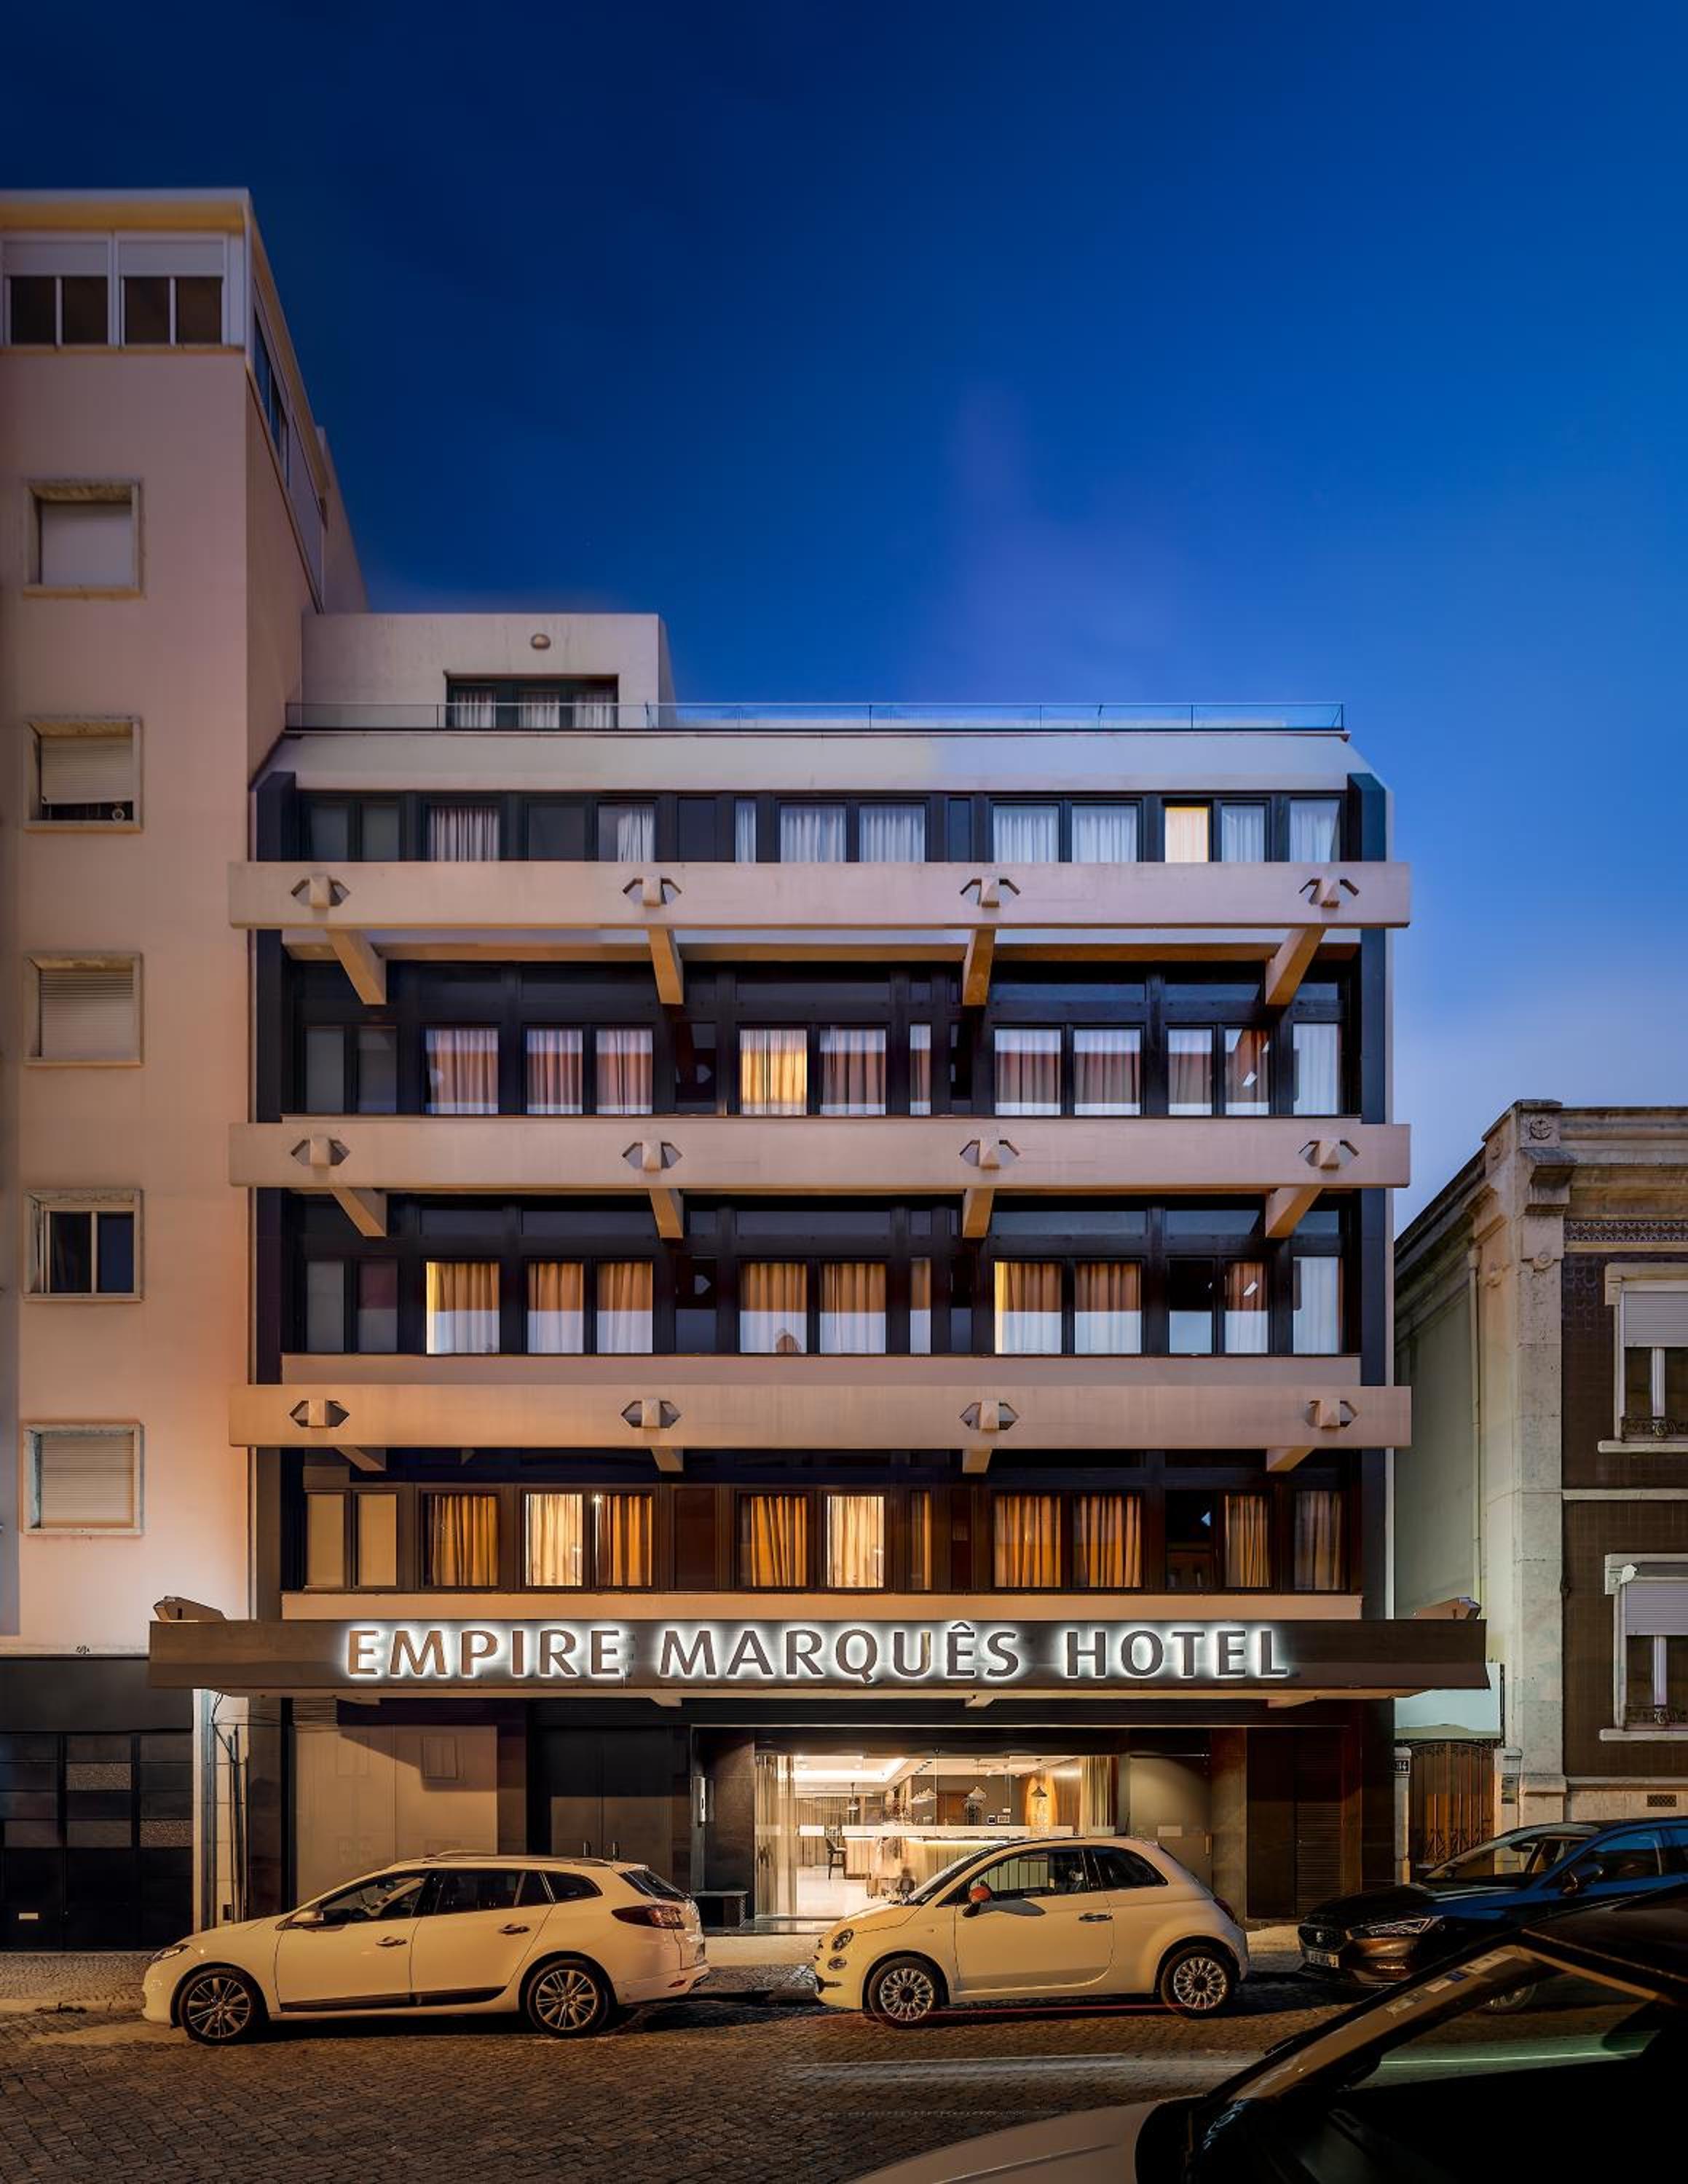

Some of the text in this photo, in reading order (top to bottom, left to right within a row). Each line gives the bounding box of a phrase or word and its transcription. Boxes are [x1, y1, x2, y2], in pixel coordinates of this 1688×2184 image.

[347, 1621, 1288, 1684] EMPIRE MARQUÊS HOTEL
